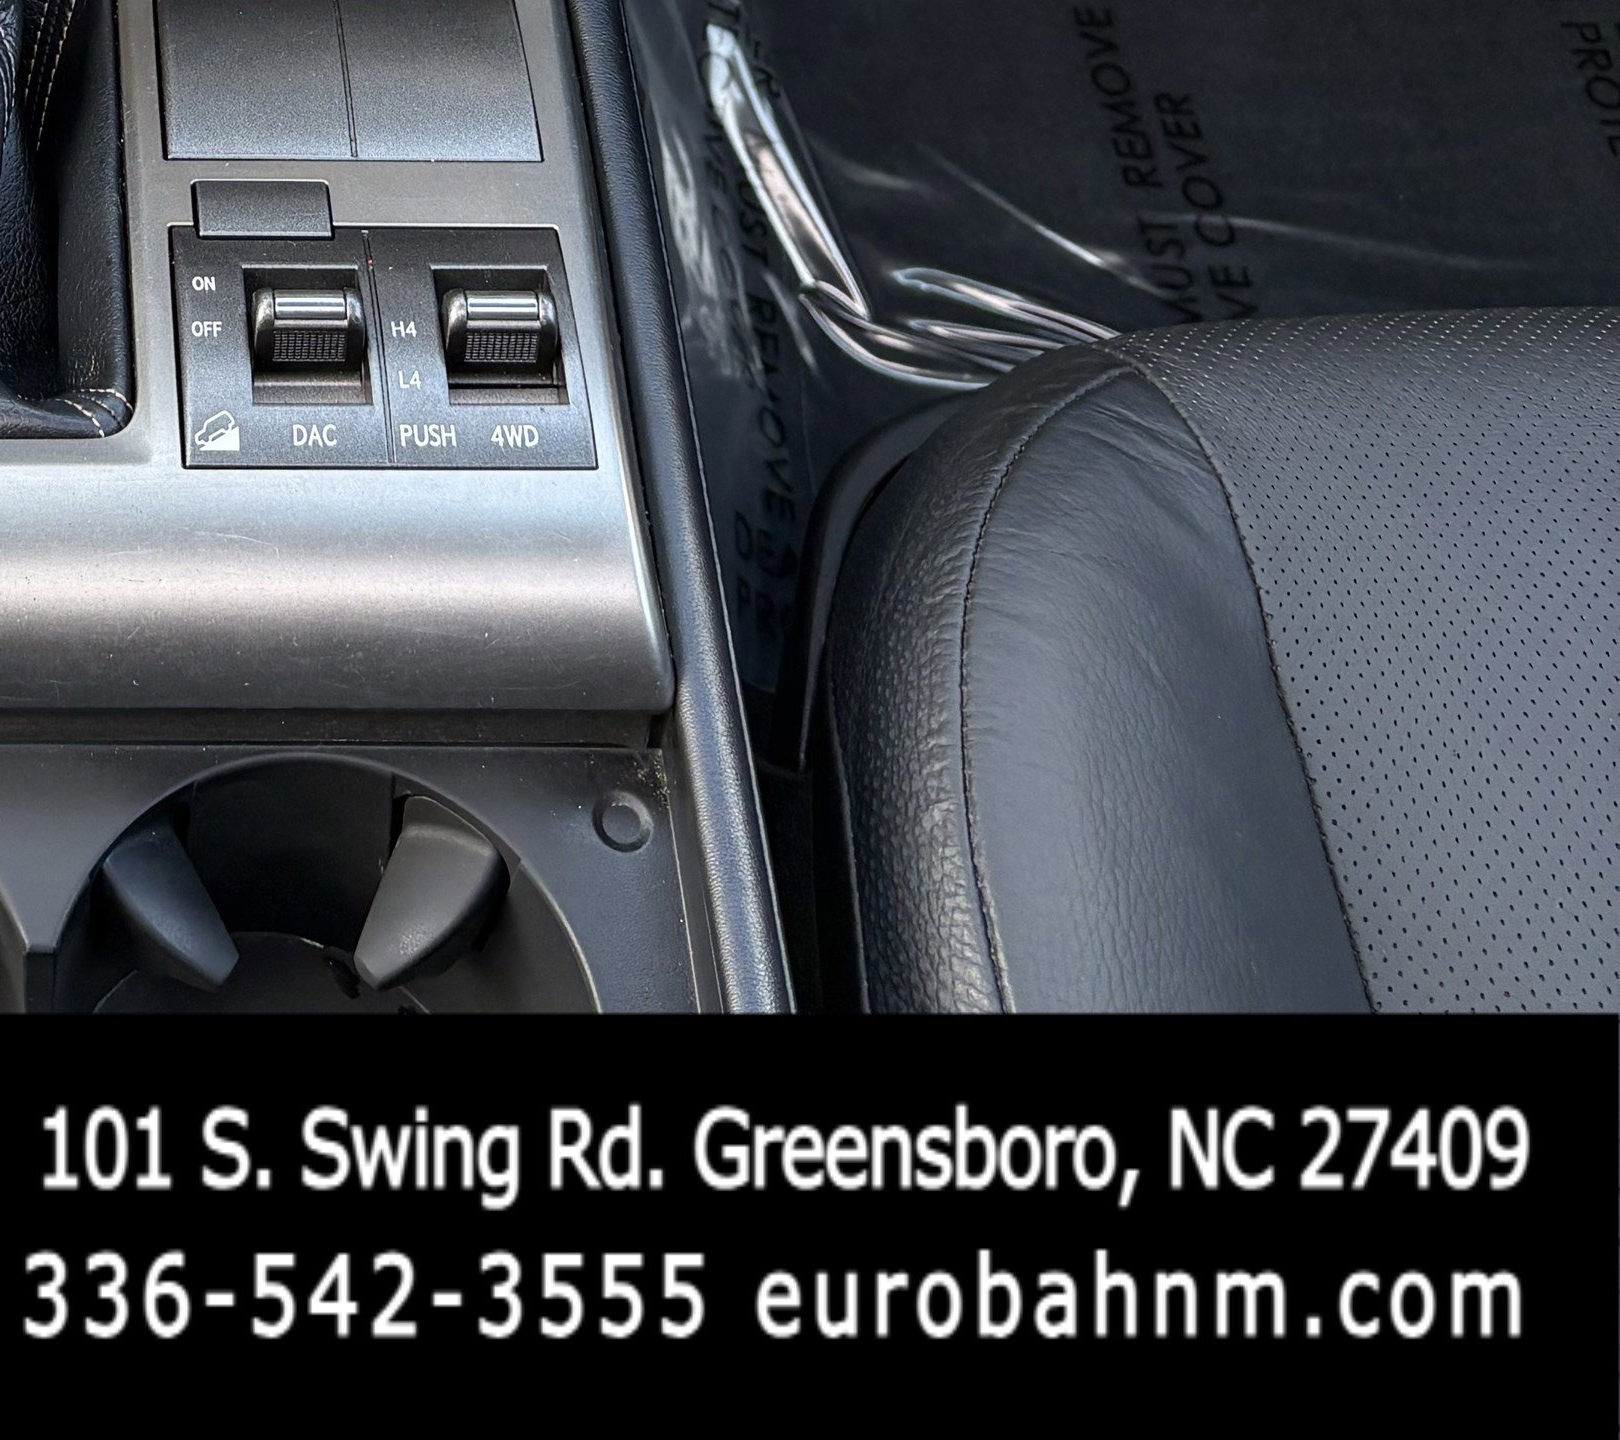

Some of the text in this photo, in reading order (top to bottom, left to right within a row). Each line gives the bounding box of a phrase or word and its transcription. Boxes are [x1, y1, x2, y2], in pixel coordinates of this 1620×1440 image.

[1073, 5, 1164, 190] REMOVE
[1154, 91, 1240, 251] COVER
[191, 276, 216, 291] ON
[191, 322, 222, 337] OFF
[391, 321, 417, 338] H4
[398, 371, 421, 389] L4
[293, 424, 338, 447] DAC
[400, 424, 539, 447] PUSH 4WD
